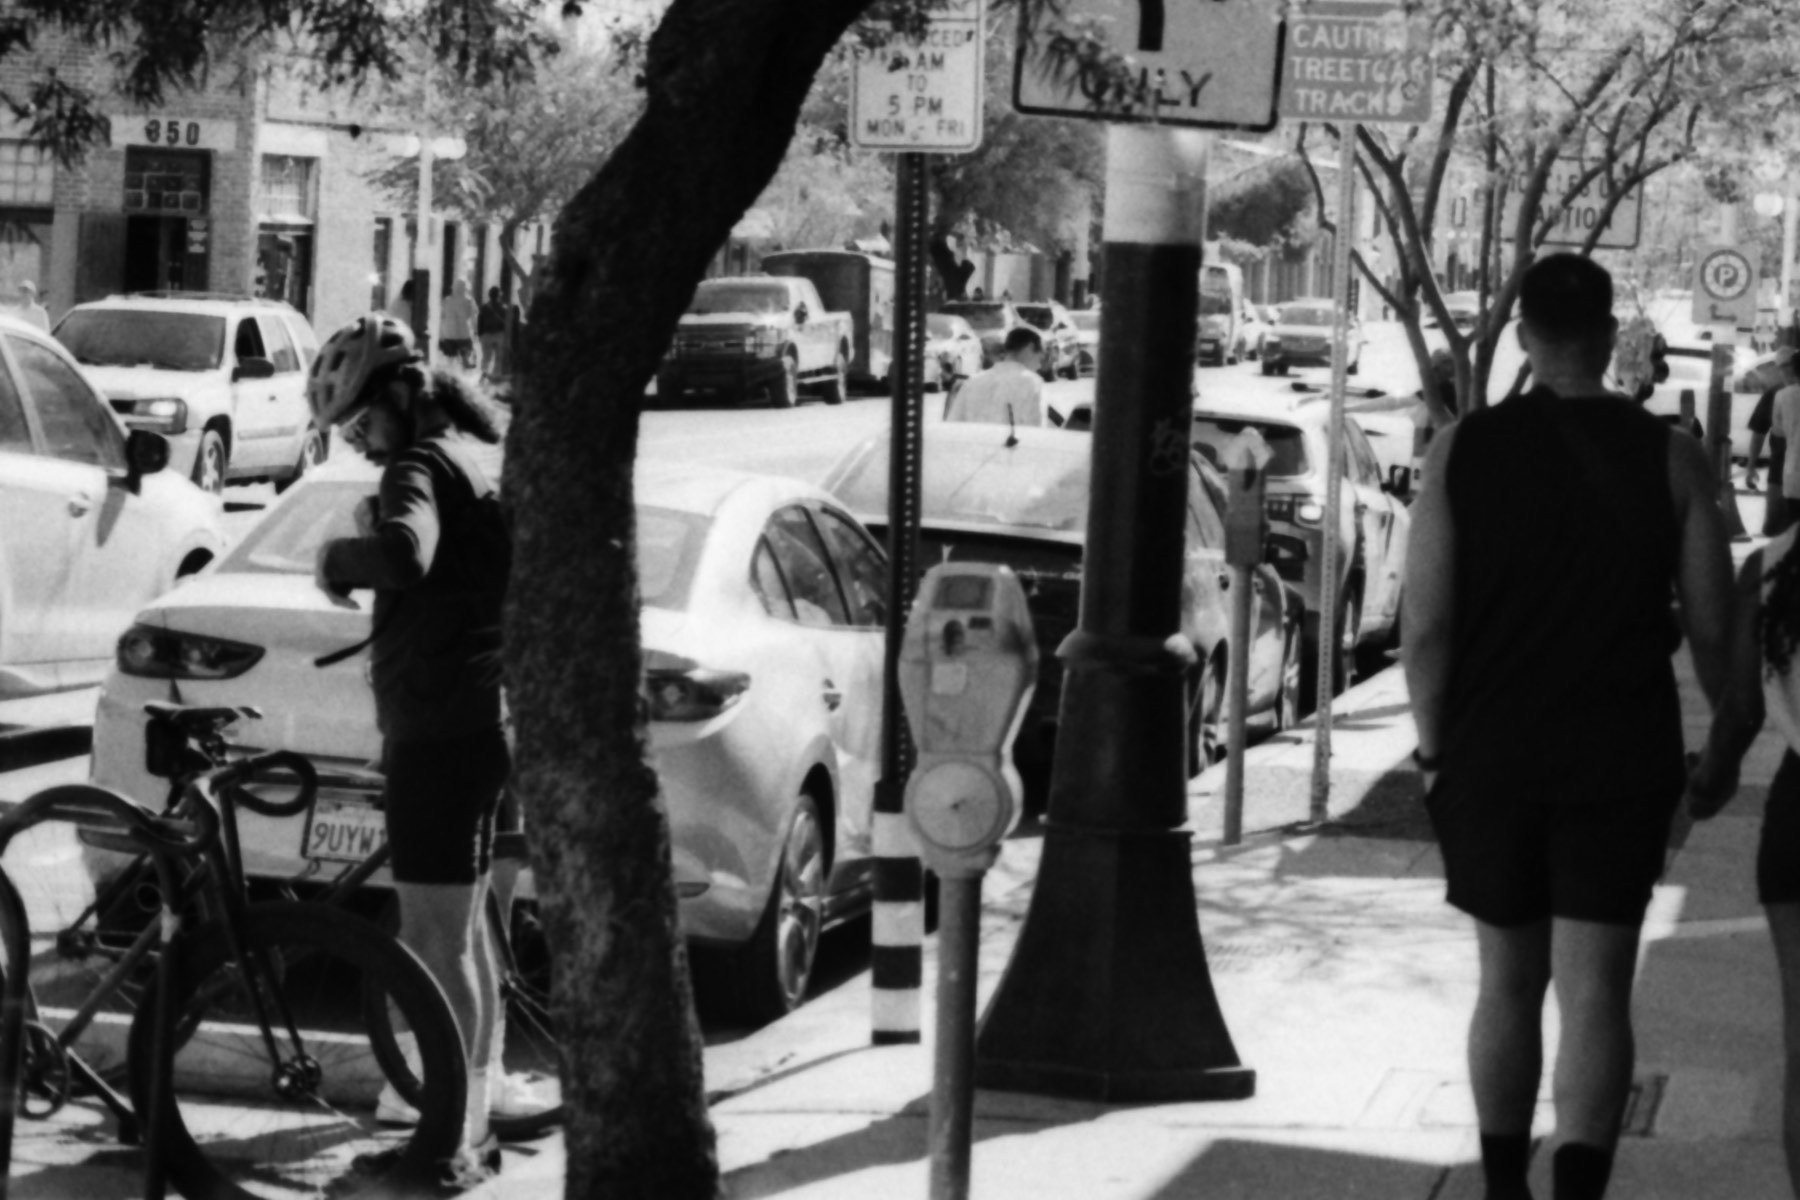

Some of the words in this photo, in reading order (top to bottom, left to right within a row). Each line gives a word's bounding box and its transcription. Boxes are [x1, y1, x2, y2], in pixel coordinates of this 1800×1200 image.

[916, 51, 945, 72] AM
[1291, 55, 1425, 84] TREETCAR
[906, 74, 928, 92] TO
[888, 95, 900, 116] 5
[914, 97, 943, 116] PM
[866, 119, 905, 137] MON
[936, 119, 965, 137] FRI
